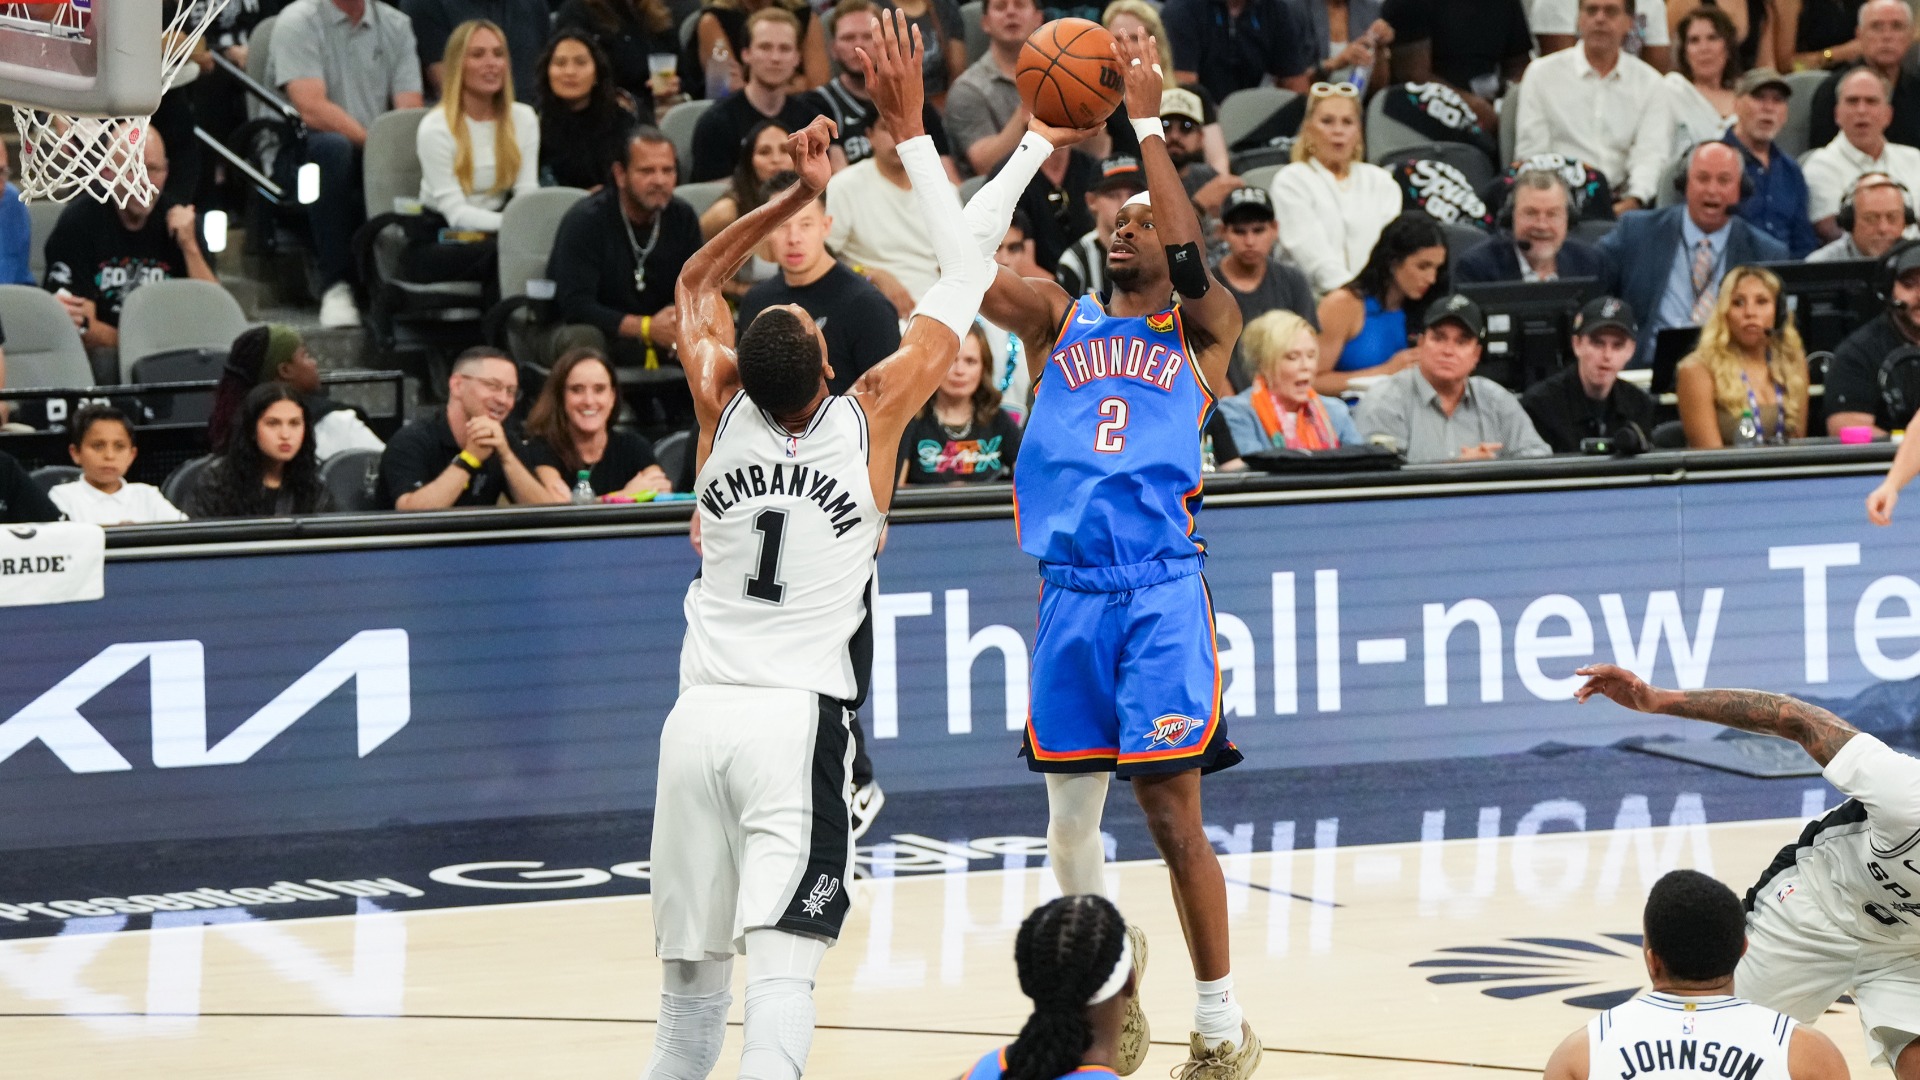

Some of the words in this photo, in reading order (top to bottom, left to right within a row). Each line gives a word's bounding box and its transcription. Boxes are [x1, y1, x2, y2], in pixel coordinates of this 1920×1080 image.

[1052, 336, 1184, 392] THUNDER
[1093, 395, 1130, 454] 2
[700, 463, 862, 539] WEMBANYAMA
[0, 555, 65, 576] RADE
[741, 505, 790, 607] 1
[872, 588, 1030, 740] Th
[1216, 568, 1725, 718] all-new
[1155, 720, 1184, 741] OKC
[305, 877, 425, 898] by
[1619, 1039, 1764, 1080] JOHNSON
